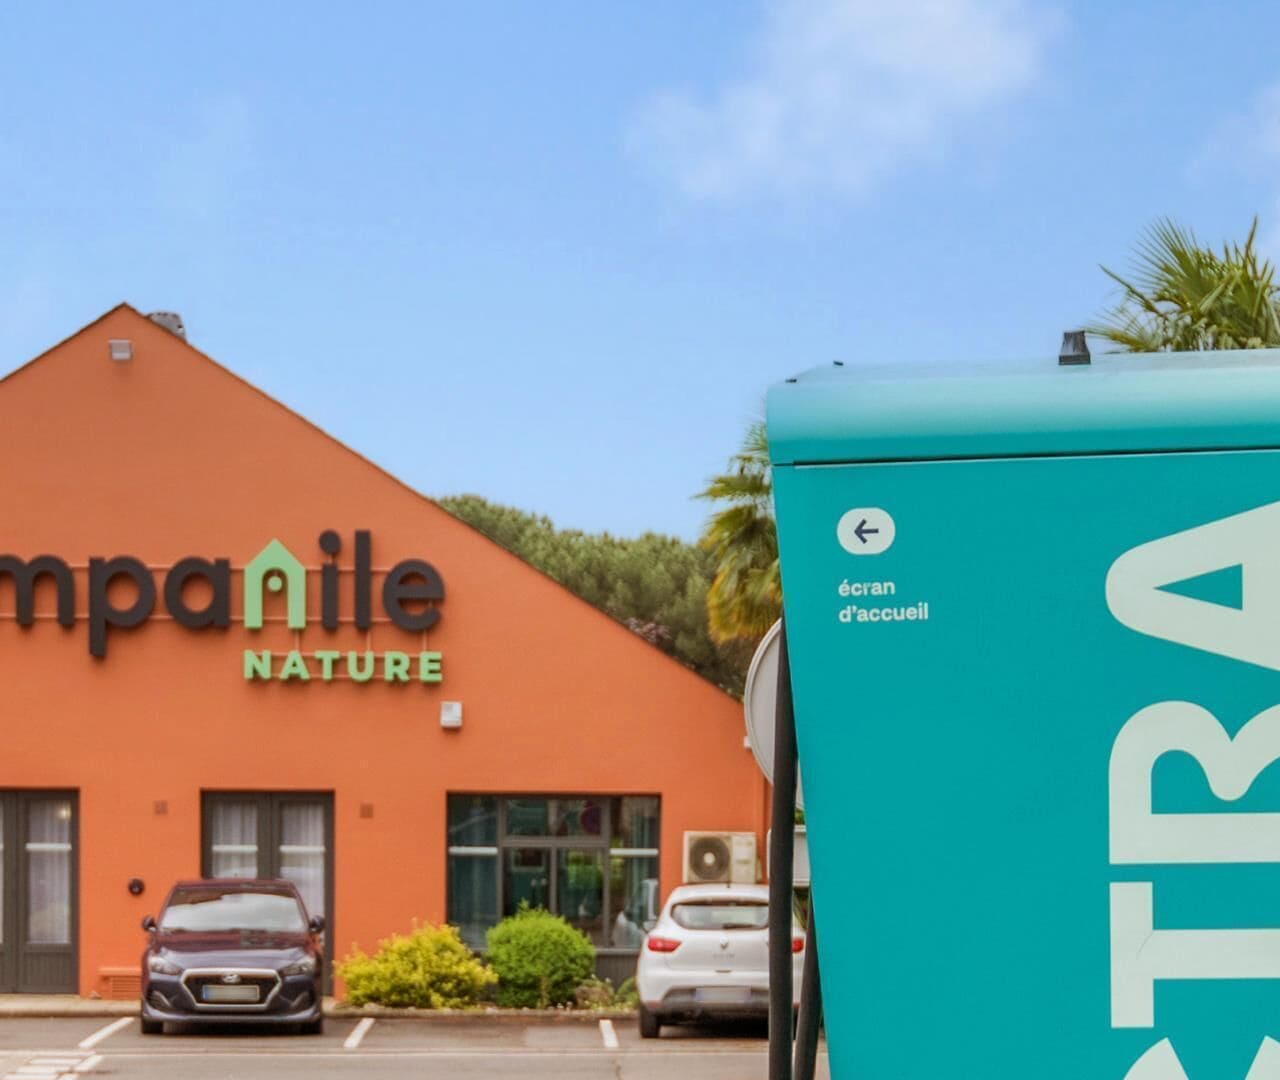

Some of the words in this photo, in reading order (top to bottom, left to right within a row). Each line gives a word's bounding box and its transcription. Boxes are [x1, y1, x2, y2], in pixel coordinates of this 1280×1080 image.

[837, 579, 896, 597] écran
[837, 602, 929, 622] d'accueil
[243, 649, 443, 683] NATURE
